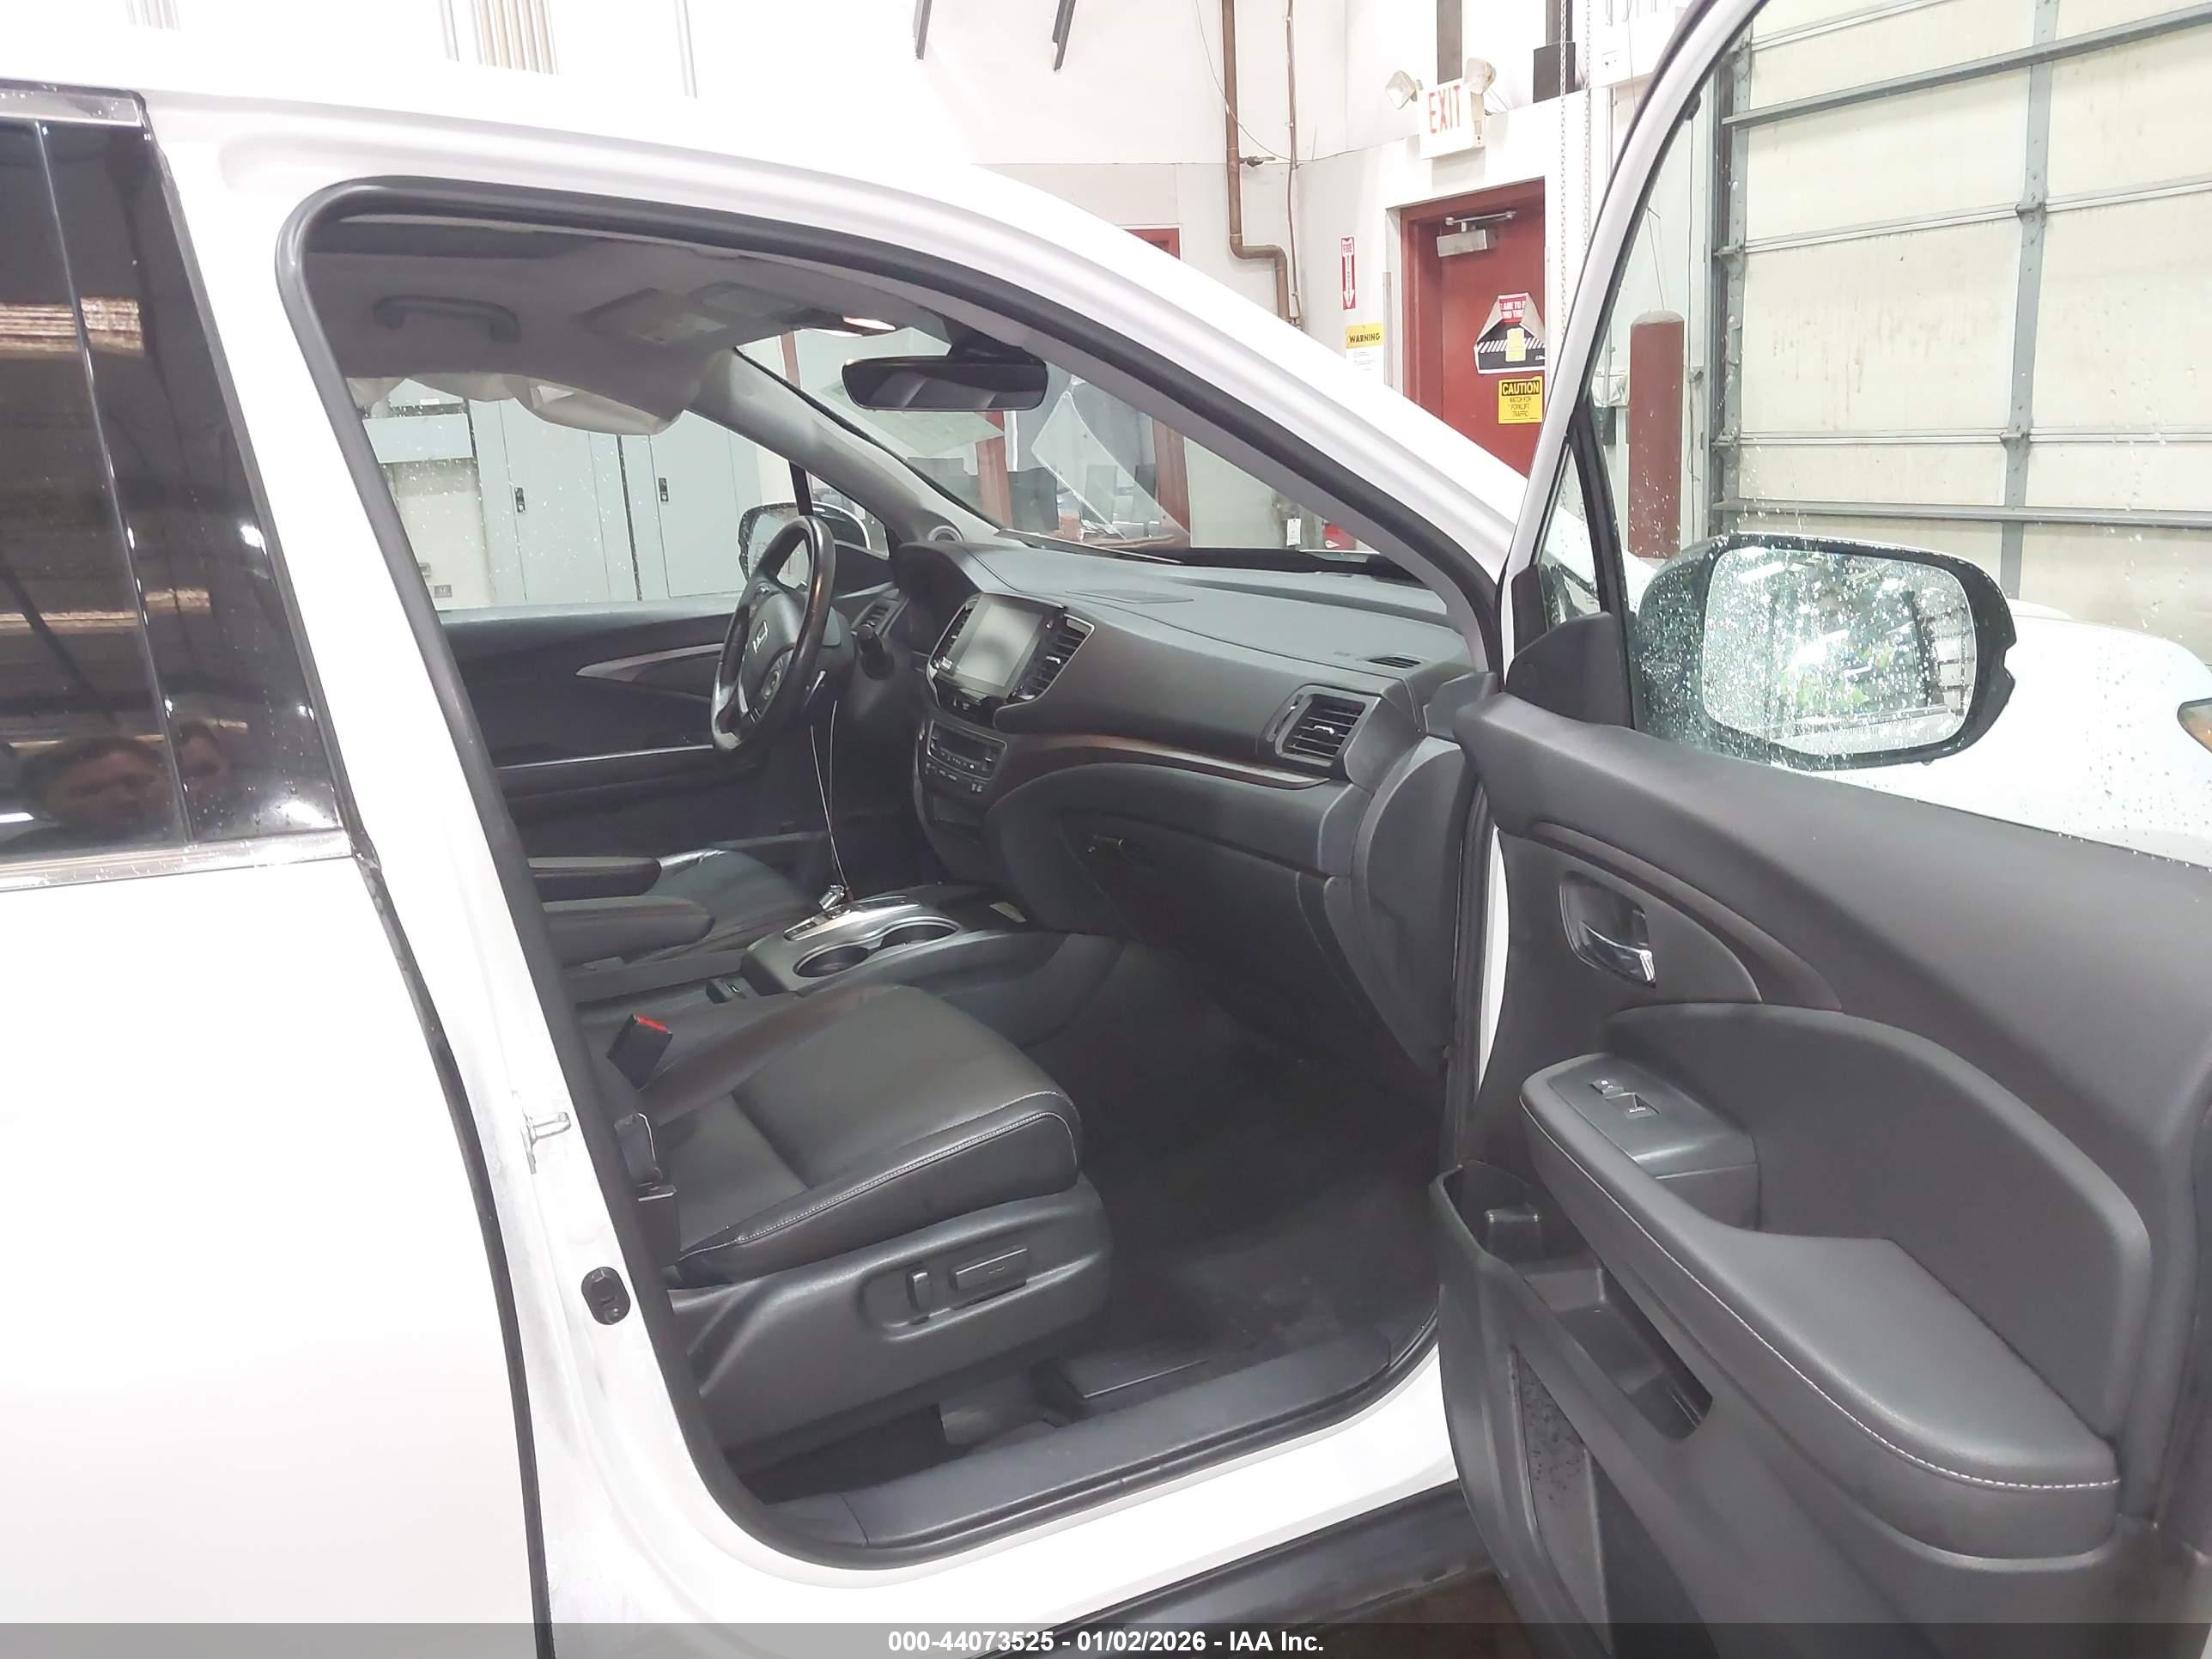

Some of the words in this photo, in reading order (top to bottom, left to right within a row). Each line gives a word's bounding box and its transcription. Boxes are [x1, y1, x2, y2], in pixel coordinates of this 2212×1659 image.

[1428, 85, 1461, 133] EXIT
[1349, 332, 1381, 343] WARNING
[1503, 381, 1540, 395] CAUTION
